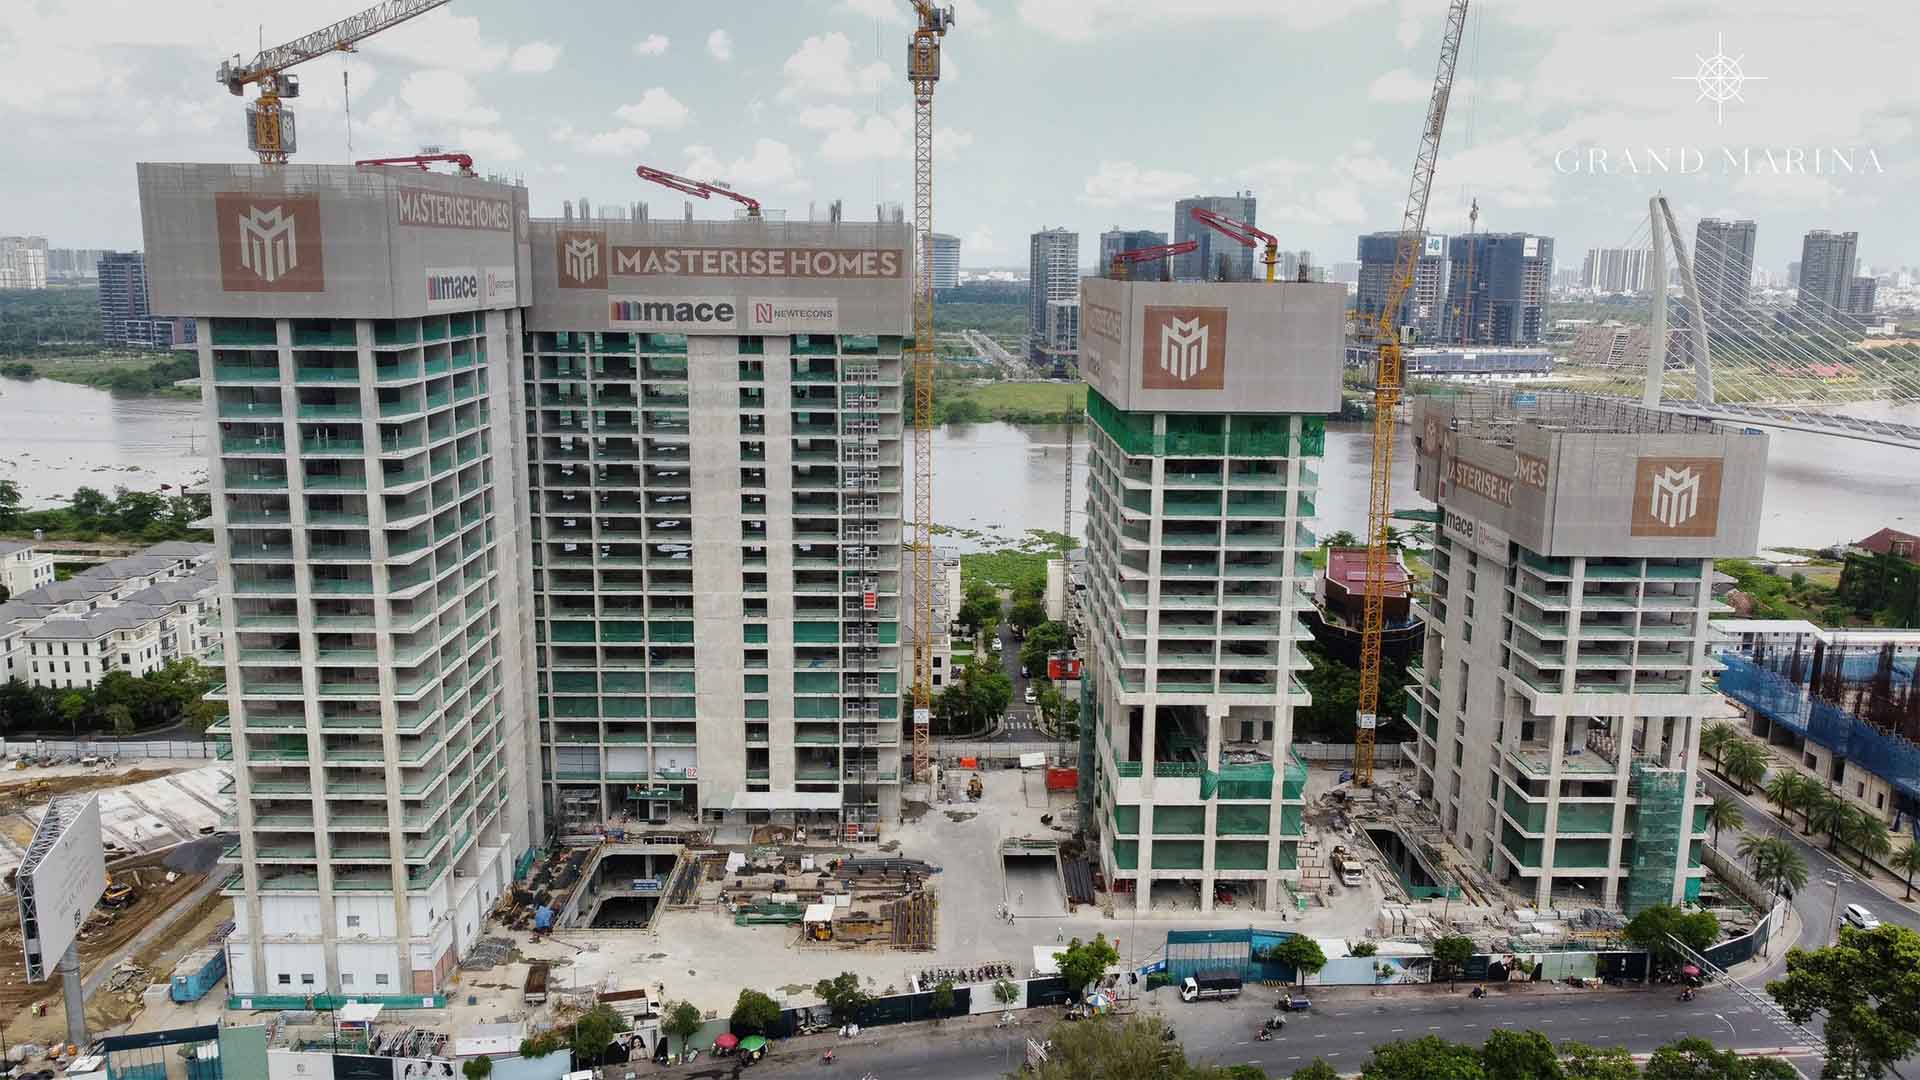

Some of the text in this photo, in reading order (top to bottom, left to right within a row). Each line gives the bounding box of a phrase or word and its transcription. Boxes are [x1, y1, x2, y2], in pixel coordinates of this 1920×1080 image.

[441, 275, 478, 299] mace
[644, 302, 734, 322] mace
[774, 309, 833, 318] NEWTECONS
[1446, 511, 1474, 538] mace
